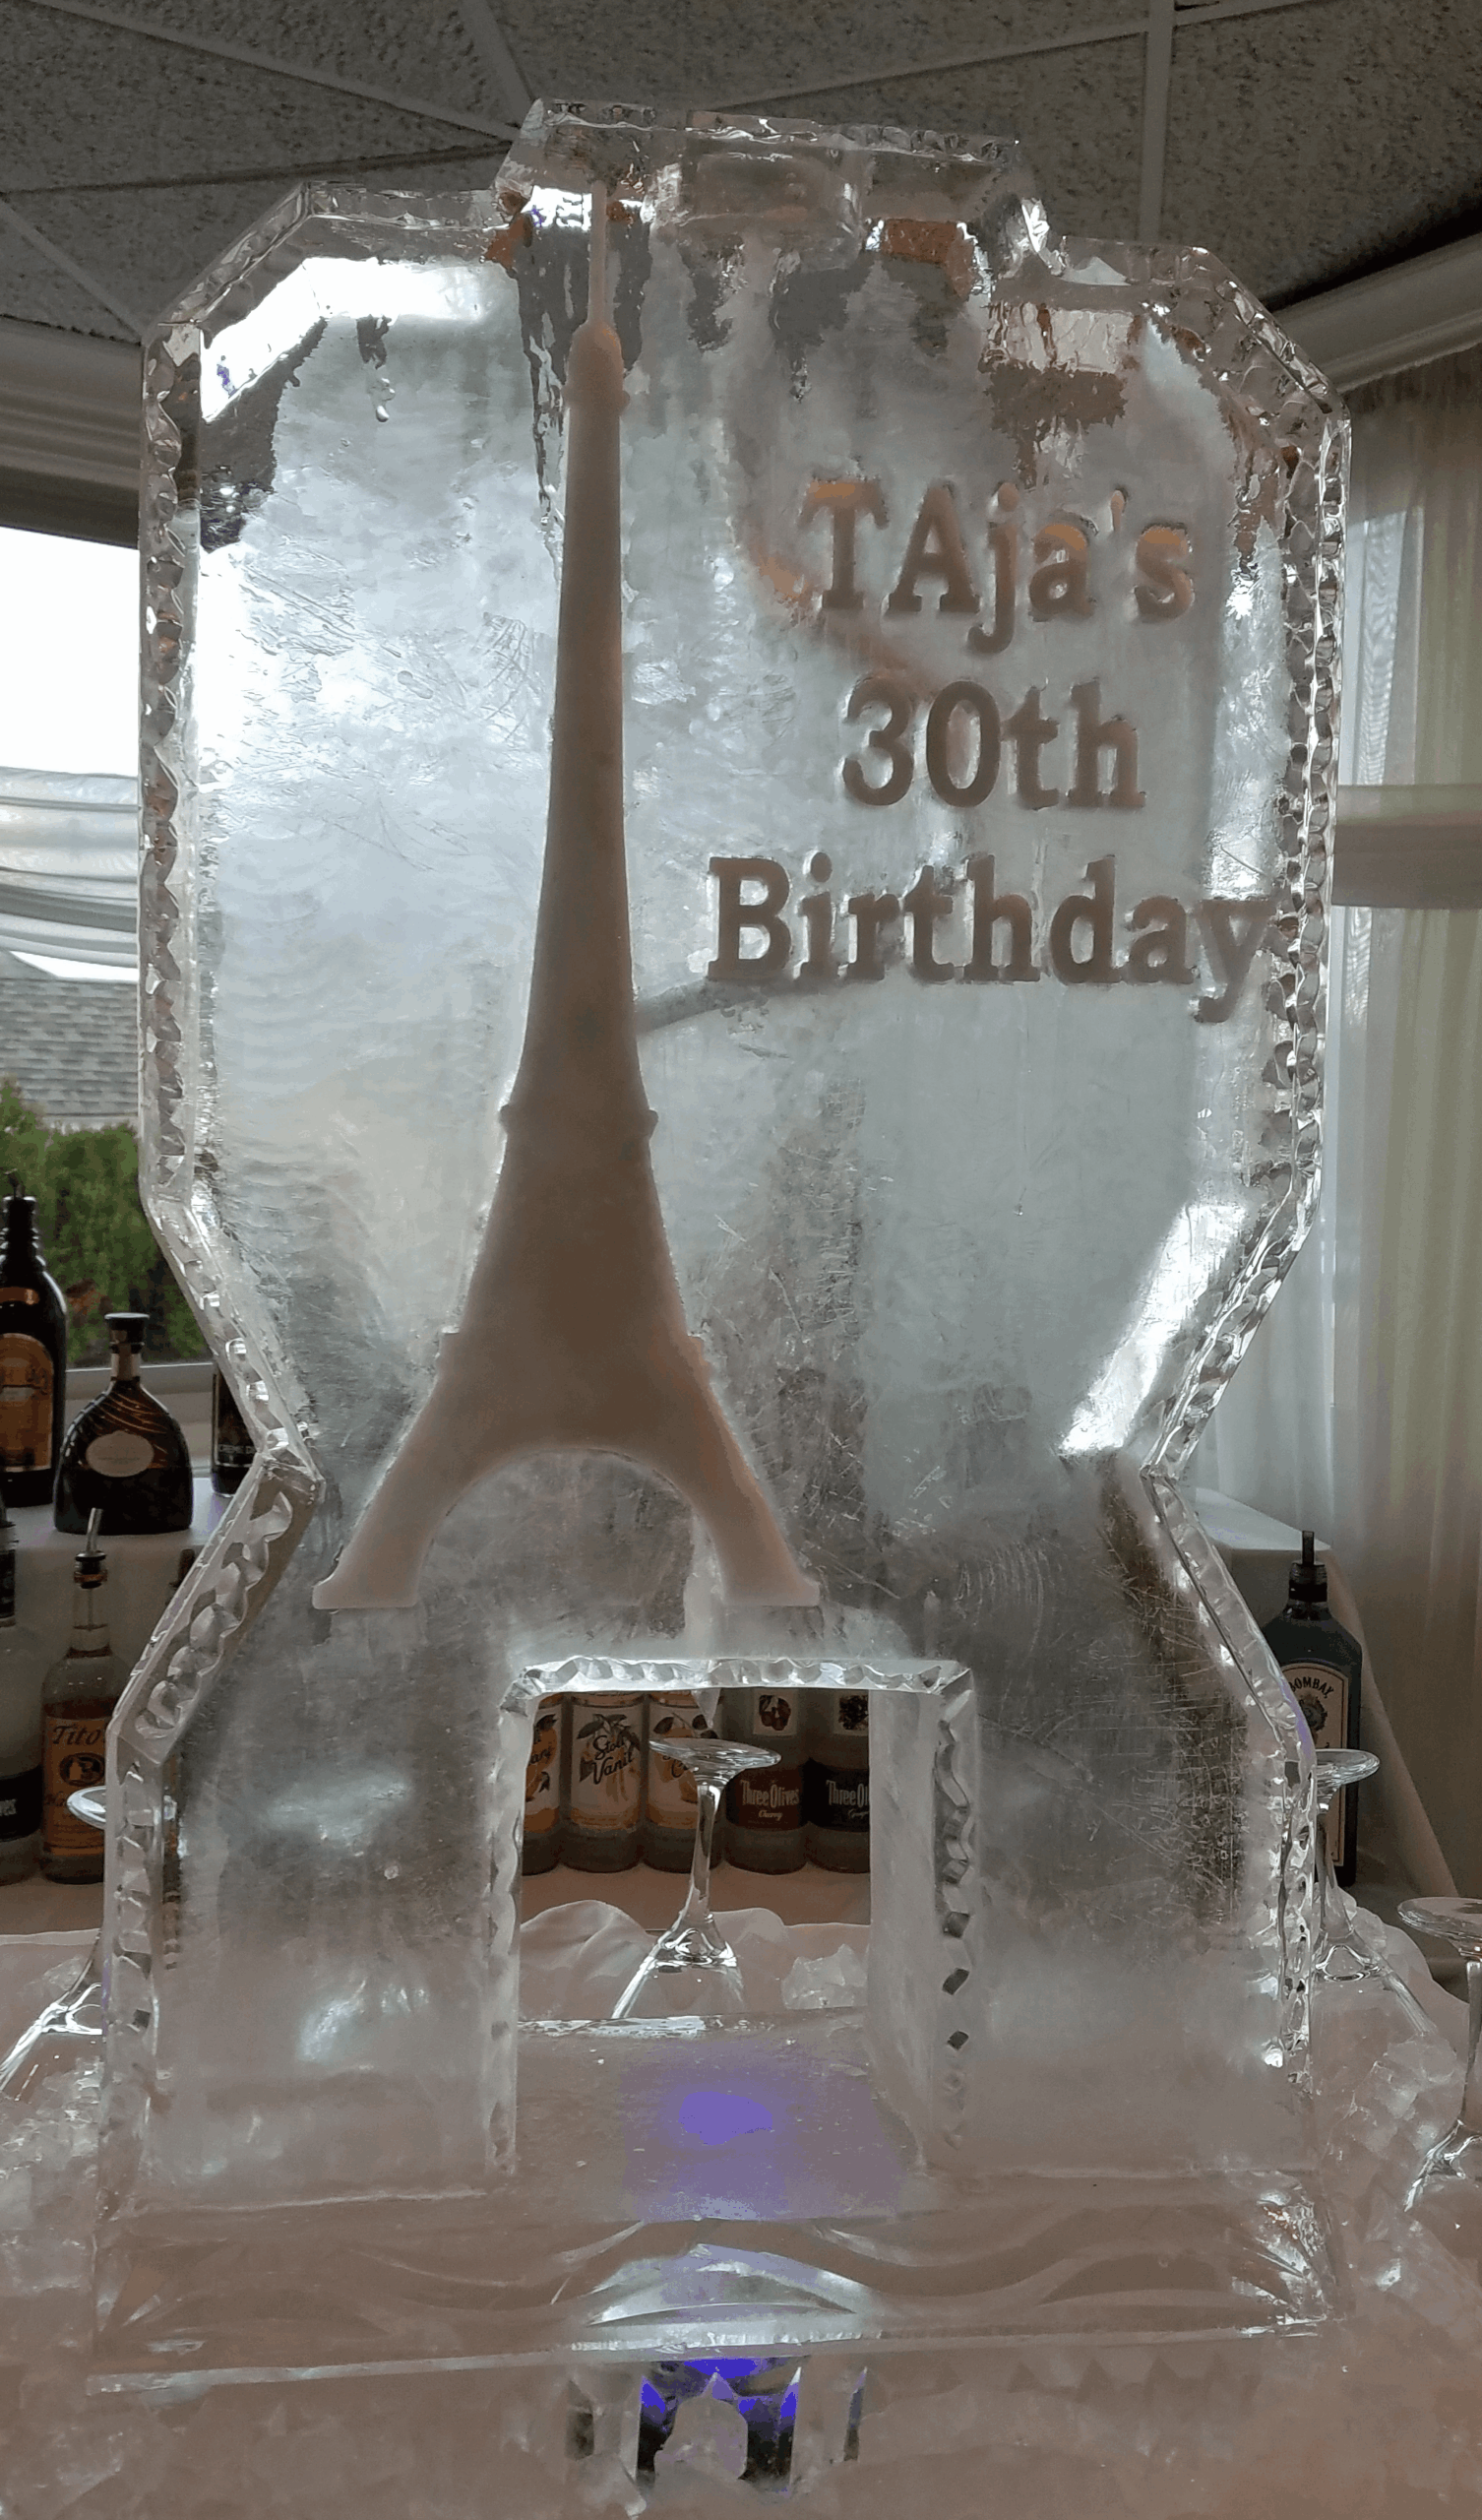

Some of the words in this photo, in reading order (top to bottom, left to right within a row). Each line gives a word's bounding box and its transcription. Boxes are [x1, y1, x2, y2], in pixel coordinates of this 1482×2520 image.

[798, 479, 1195, 654] TAja's
[841, 678, 1146, 810] 30th
[706, 852, 1275, 1023] Birthday
[52, 1724, 104, 1745] Tito
[740, 1779, 770, 1806] Three
[771, 1780, 800, 1808] Olives
[827, 1779, 856, 1806] Three
